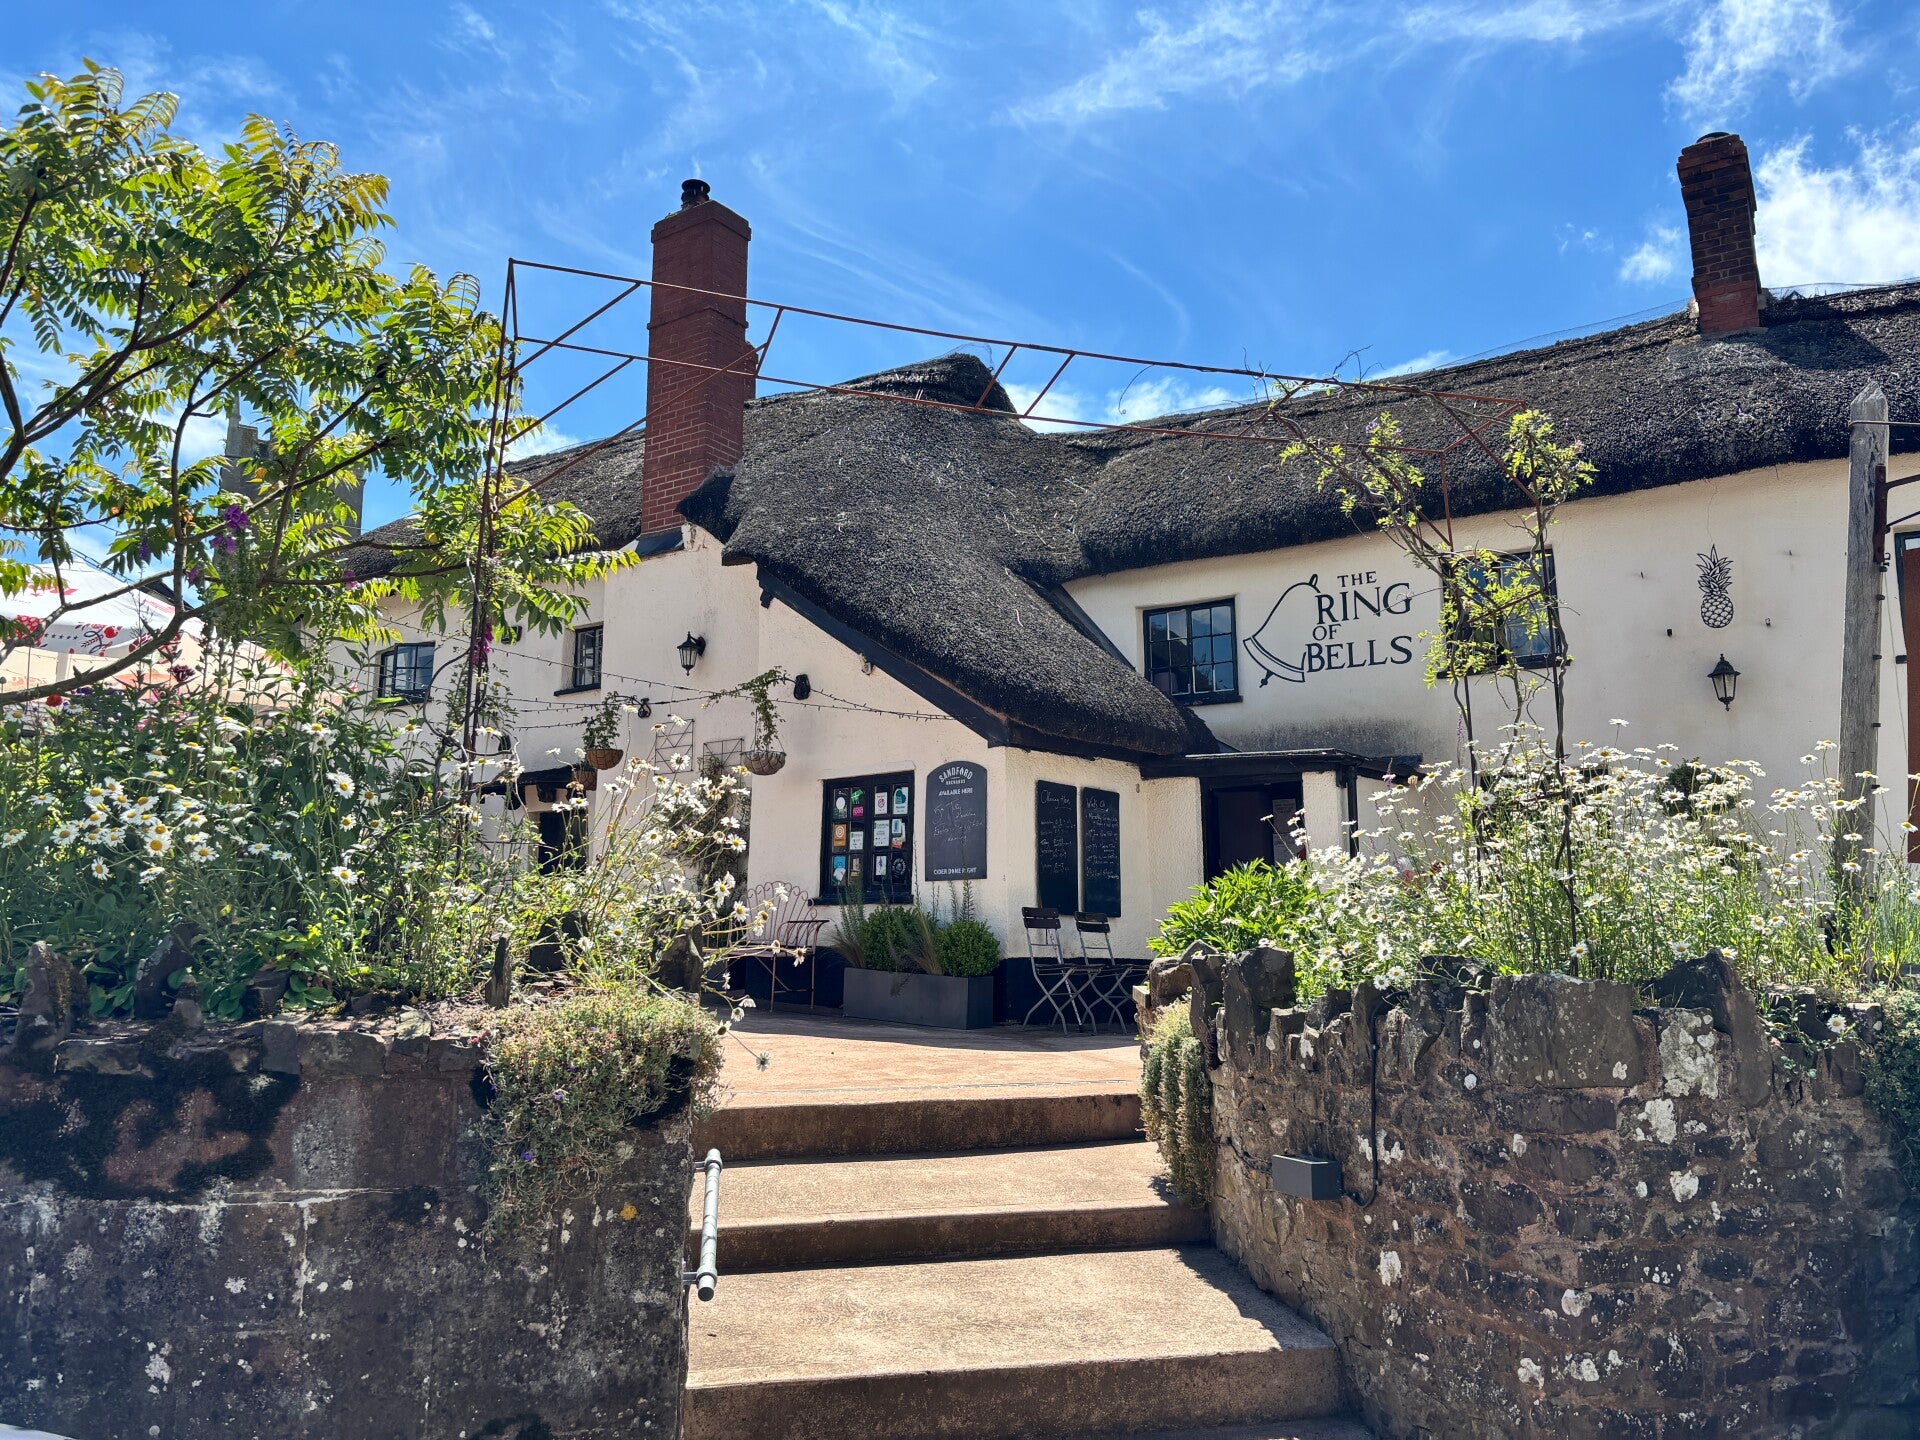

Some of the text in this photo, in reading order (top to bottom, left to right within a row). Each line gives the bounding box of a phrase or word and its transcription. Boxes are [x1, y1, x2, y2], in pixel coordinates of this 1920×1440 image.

[1337, 571, 1377, 587] THE
[1315, 583, 1412, 625] RING
[1312, 624, 1341, 640] OF
[1305, 636, 1412, 673] BELLS
[938, 766, 974, 783] SANDFORD
[938, 788, 961, 796] AVAILABLE
